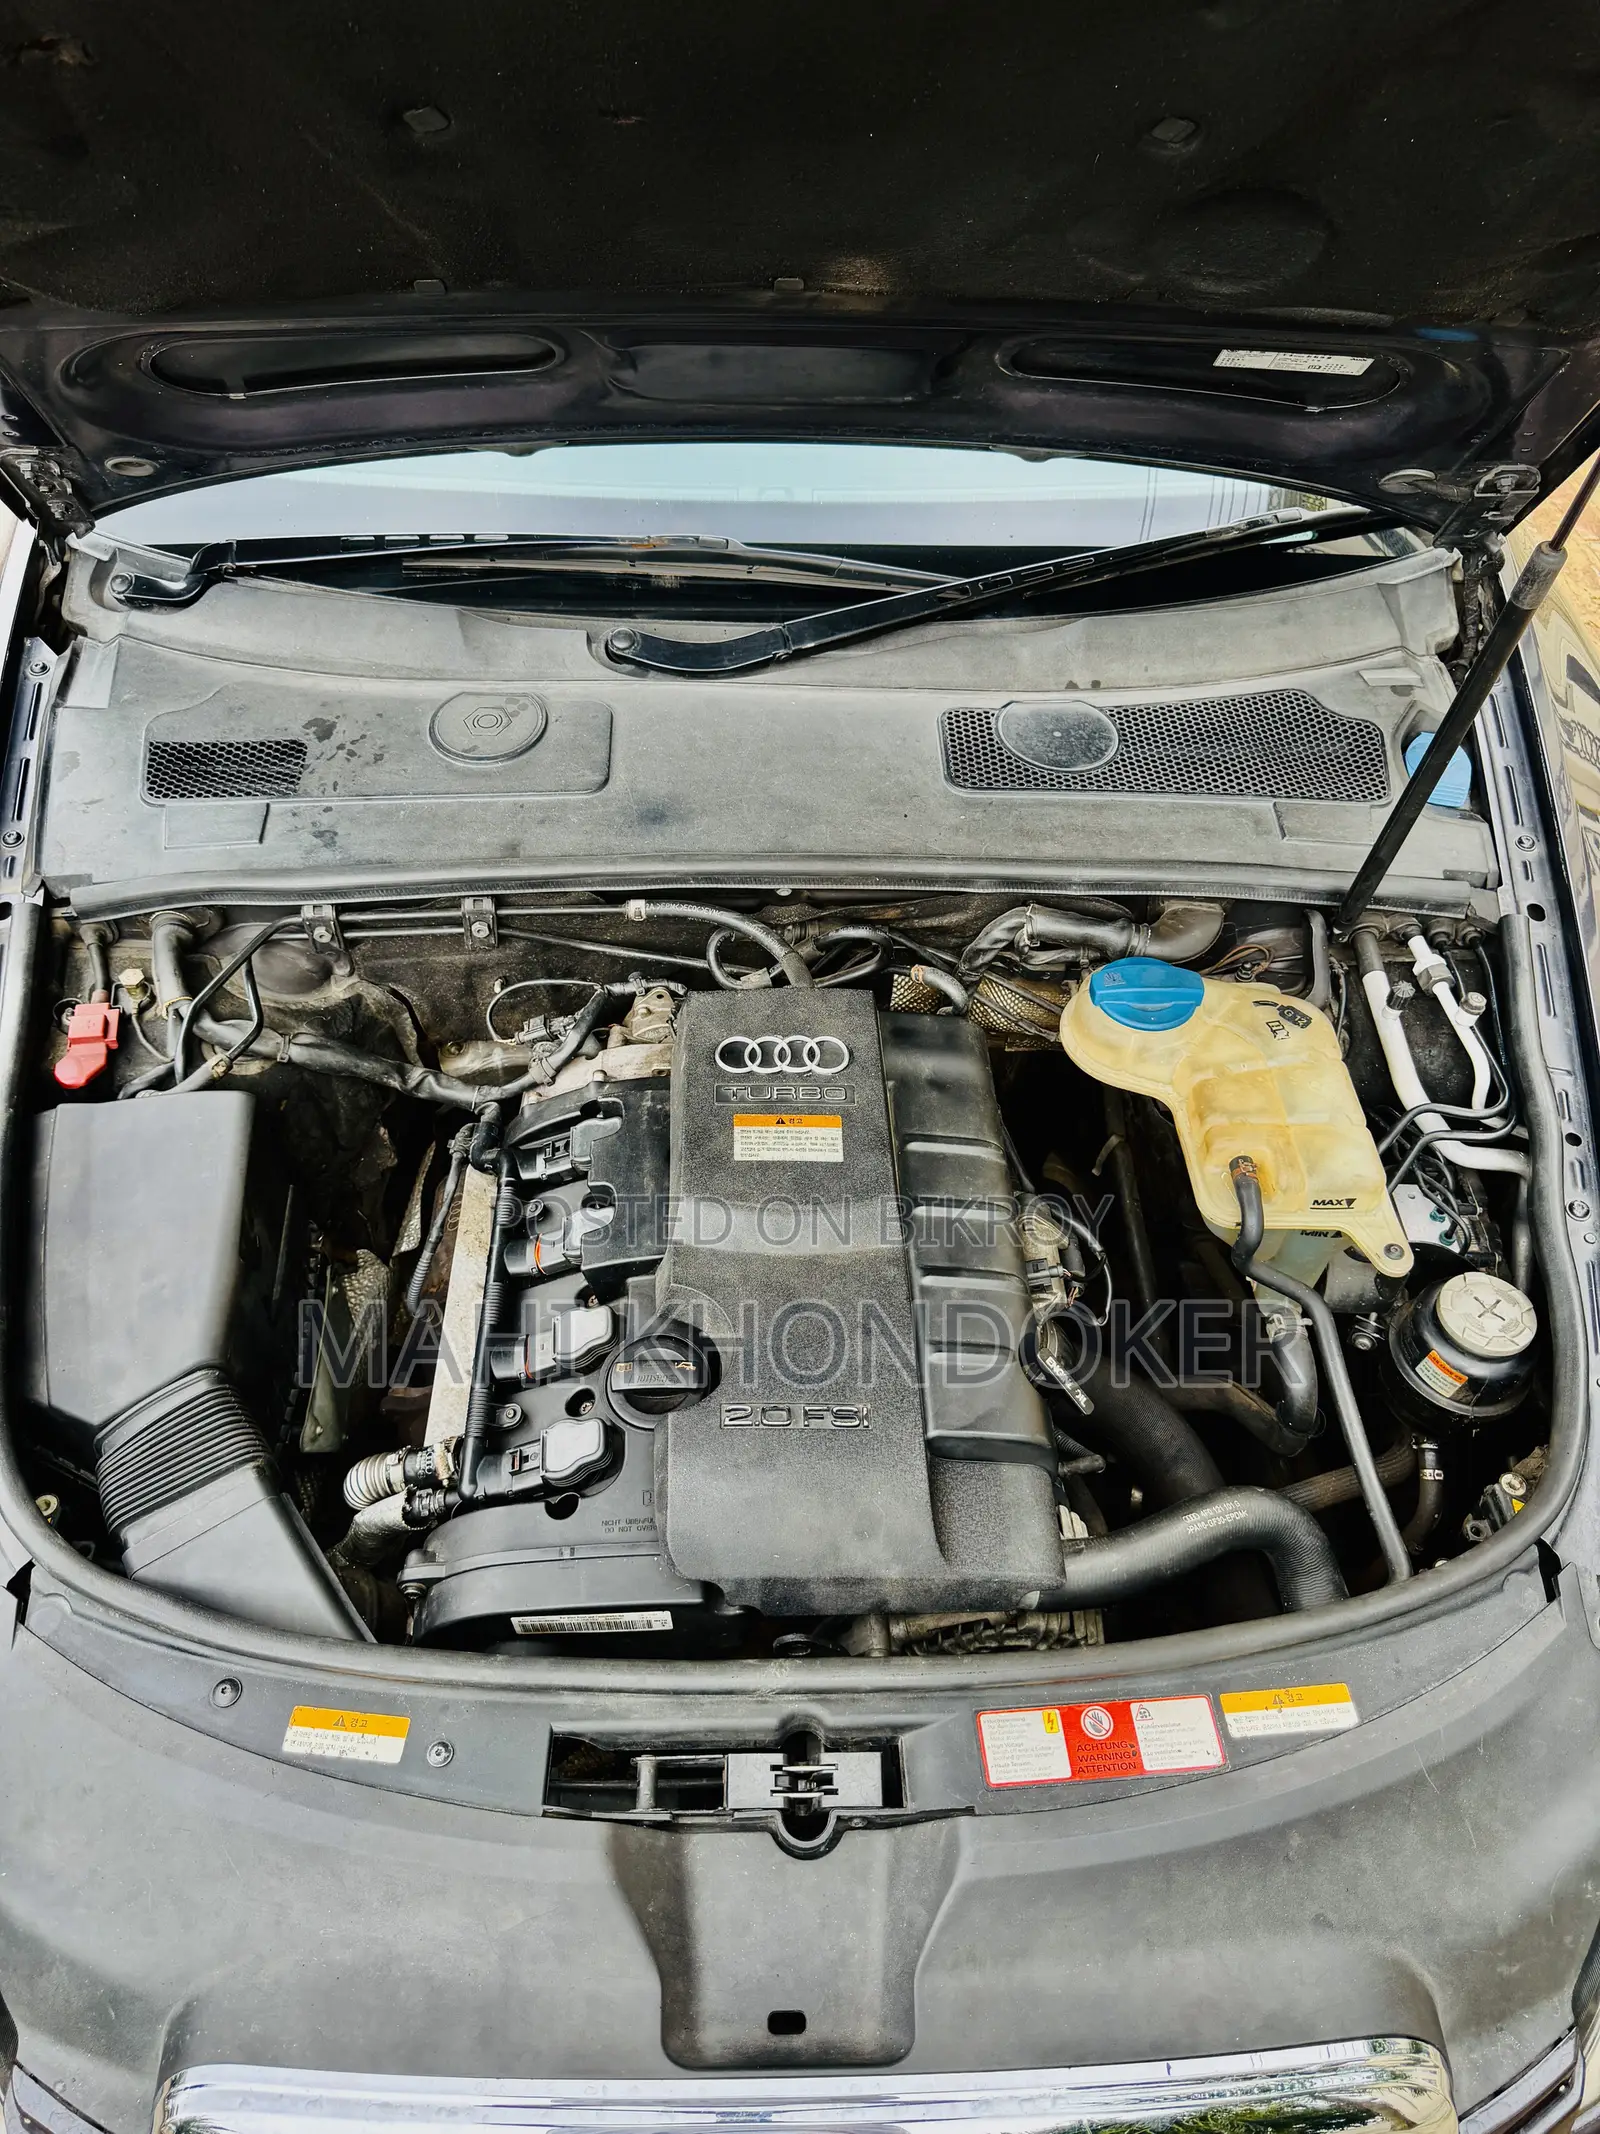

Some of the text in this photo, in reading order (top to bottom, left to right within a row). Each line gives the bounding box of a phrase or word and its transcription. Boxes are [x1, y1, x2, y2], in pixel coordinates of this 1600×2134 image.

[723, 1085, 847, 1101] TURBO
[1312, 1198, 1345, 1206] MAX
[1300, 1229, 1330, 1238] MIN
[1045, 1356, 1088, 1408] ENGINE OIL
[723, 1404, 870, 1428] 2.0 FSI
[604, 1526, 614, 1534] DO
[618, 1525, 632, 1533] NOT
[1076, 1740, 1129, 1753] ACHTUNG
[1077, 1750, 1131, 1763] WARNING
[1077, 1762, 1137, 1775] ATTENTION
